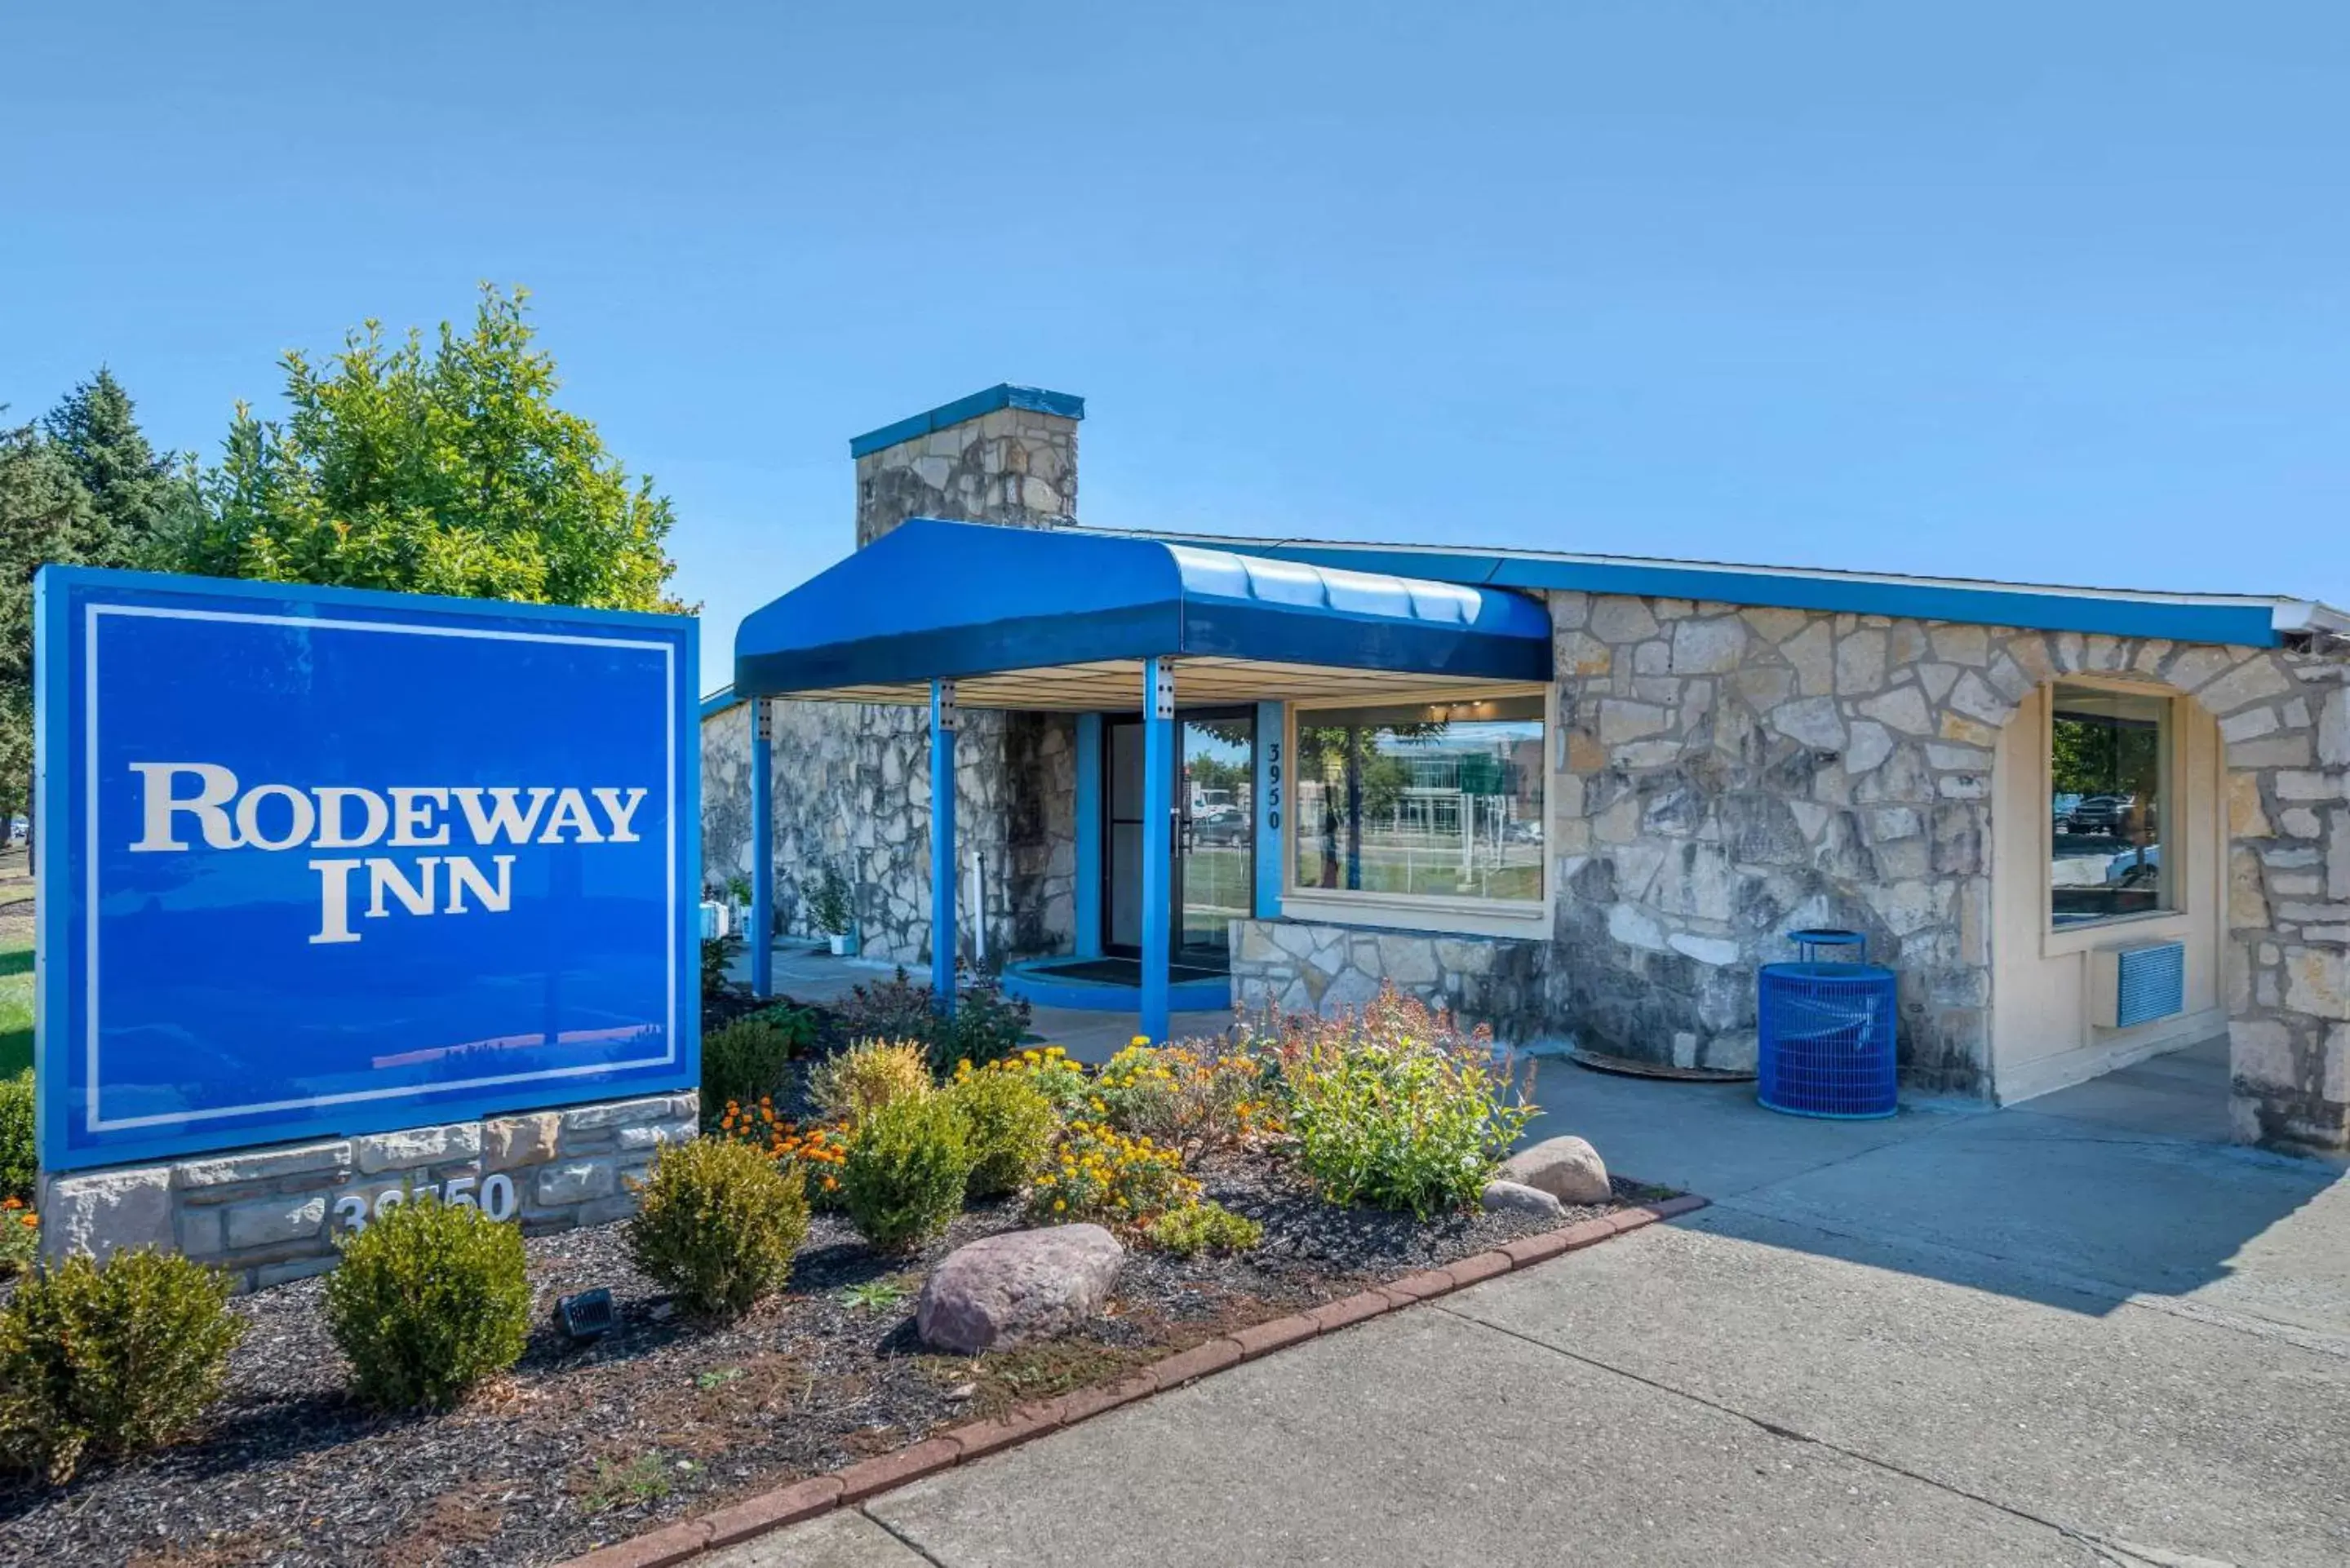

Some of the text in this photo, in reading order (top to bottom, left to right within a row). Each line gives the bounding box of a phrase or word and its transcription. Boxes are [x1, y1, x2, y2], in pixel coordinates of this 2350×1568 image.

[129, 763, 647, 851] RODEWAY
[1268, 743, 1280, 830] 3950
[308, 855, 516, 944] INN
